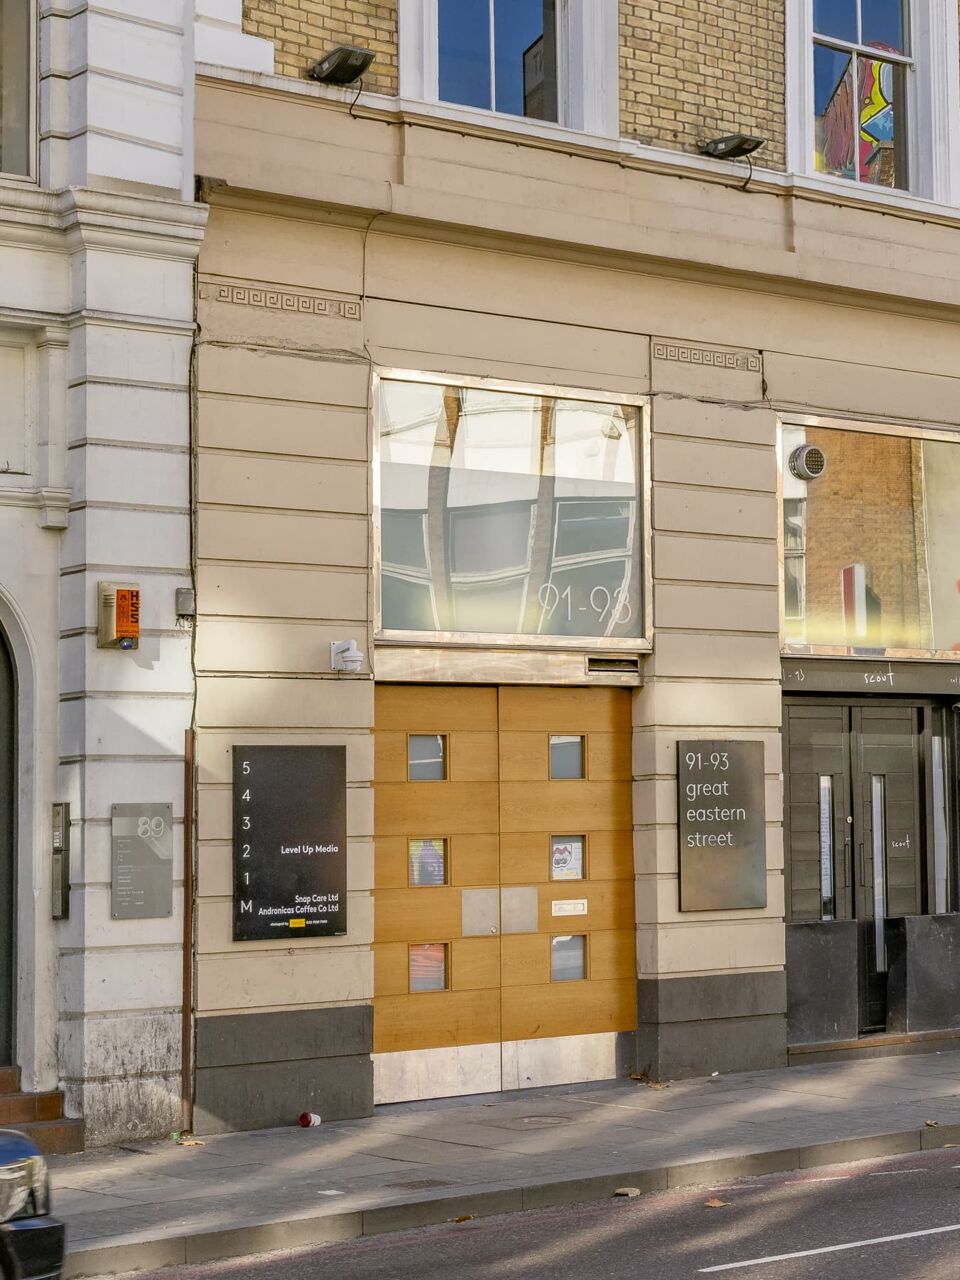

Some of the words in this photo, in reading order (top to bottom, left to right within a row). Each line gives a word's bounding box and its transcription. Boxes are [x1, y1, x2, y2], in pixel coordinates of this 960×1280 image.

[130, 591, 139, 624] HSS
[538, 583, 632, 624] 91-93
[782, 668, 806, 682] 1-93
[864, 662, 894, 686] scout
[242, 761, 251, 775] 5
[685, 752, 730, 771] 91-93
[242, 788, 251, 802] 4
[686, 780, 729, 802] great
[686, 806, 746, 822] eastern
[137, 816, 165, 838] 89
[242, 816, 251, 830] 3
[687, 831, 733, 847] street
[891, 834, 910, 849] scout
[242, 844, 251, 858] 2
[281, 845, 301, 854] Level
[302, 845, 314, 855] Up
[315, 844, 339, 853] Media
[244, 872, 249, 885] 1
[295, 895, 311, 905] Snap
[312, 894, 327, 903] Care
[328, 893, 339, 902] Ltd
[240, 900, 253, 914] M
[258, 906, 295, 915] Andronicas
[295, 905, 317, 914] Coffee
[318, 904, 327, 913] Co
[328, 904, 339, 912] Ltd
